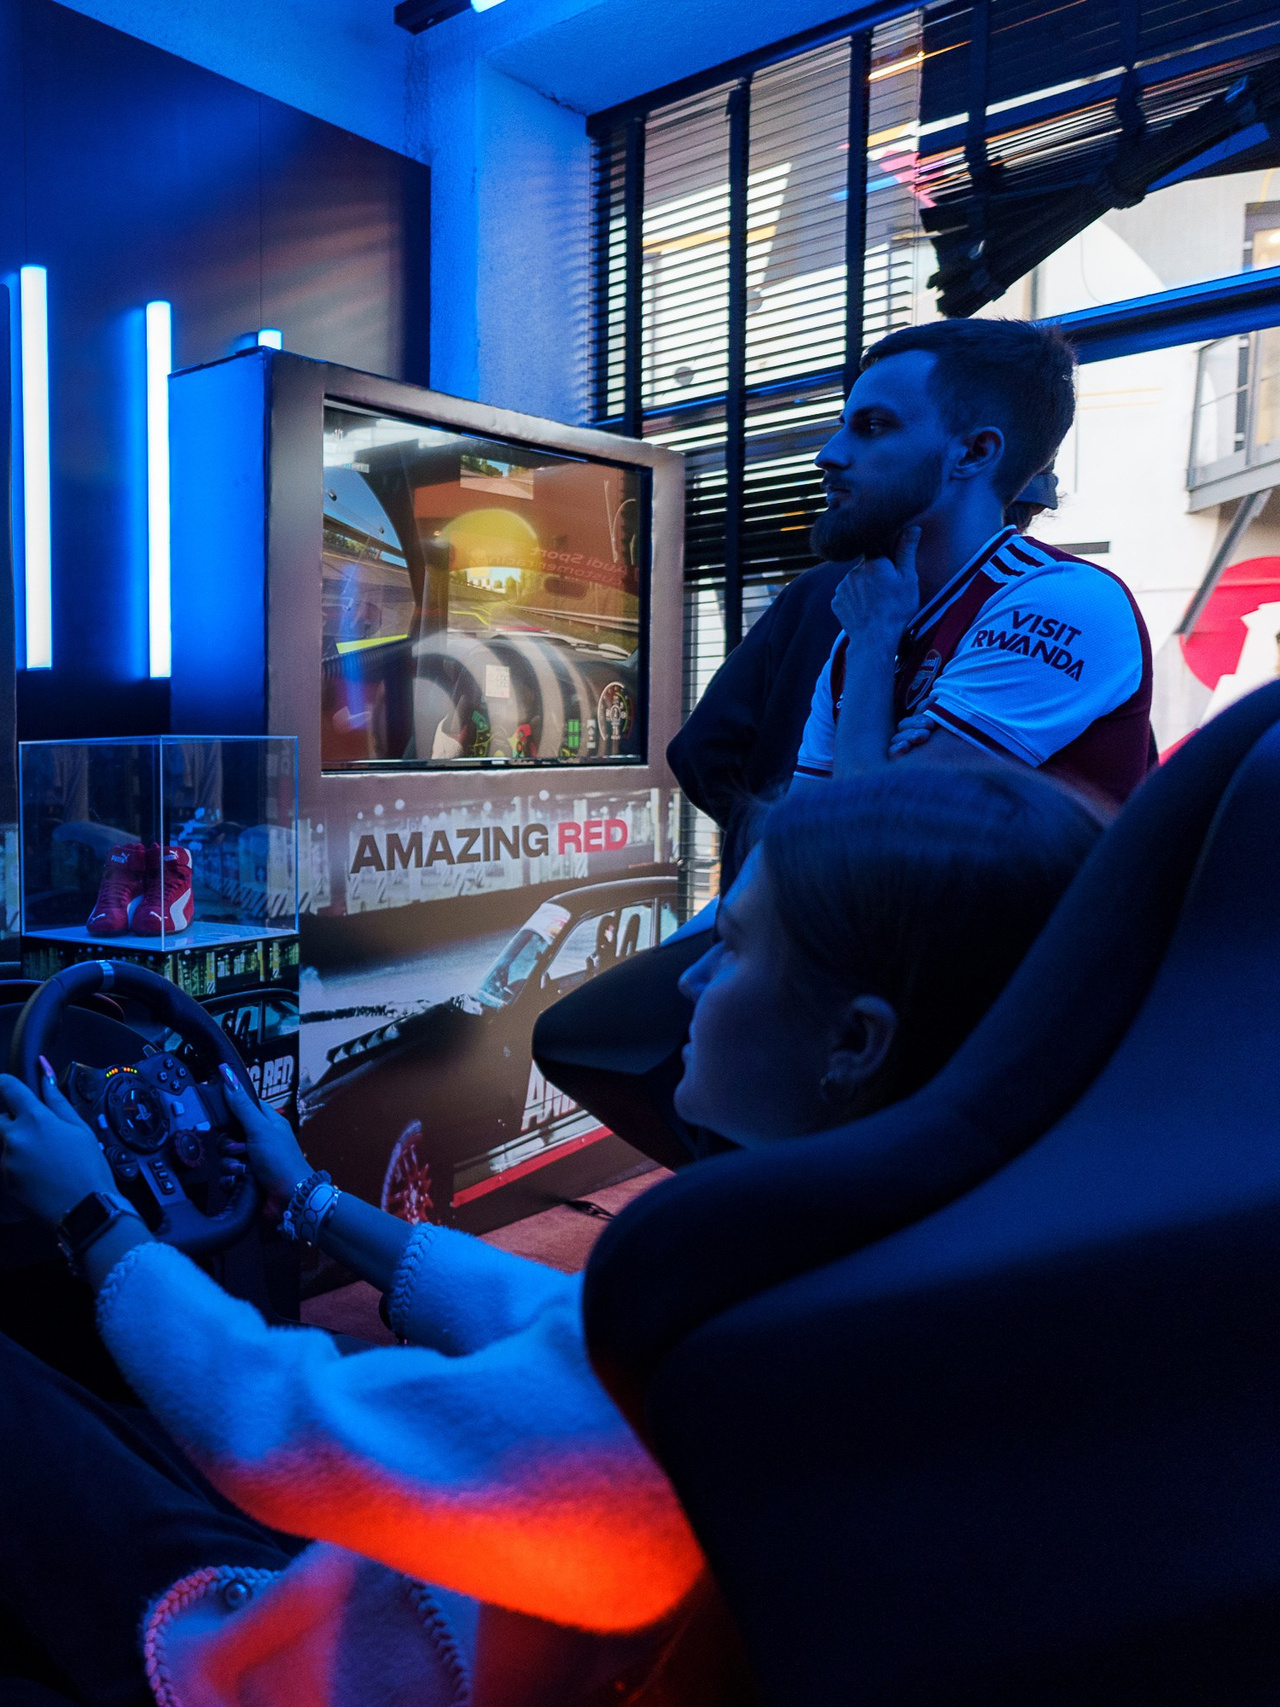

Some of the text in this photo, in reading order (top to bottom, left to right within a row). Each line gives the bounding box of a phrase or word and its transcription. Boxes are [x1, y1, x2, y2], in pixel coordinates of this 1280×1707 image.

[1012, 610, 1082, 647] VISIT
[970, 629, 1084, 682] RWANDA
[350, 818, 628, 874] AMAZING RED
